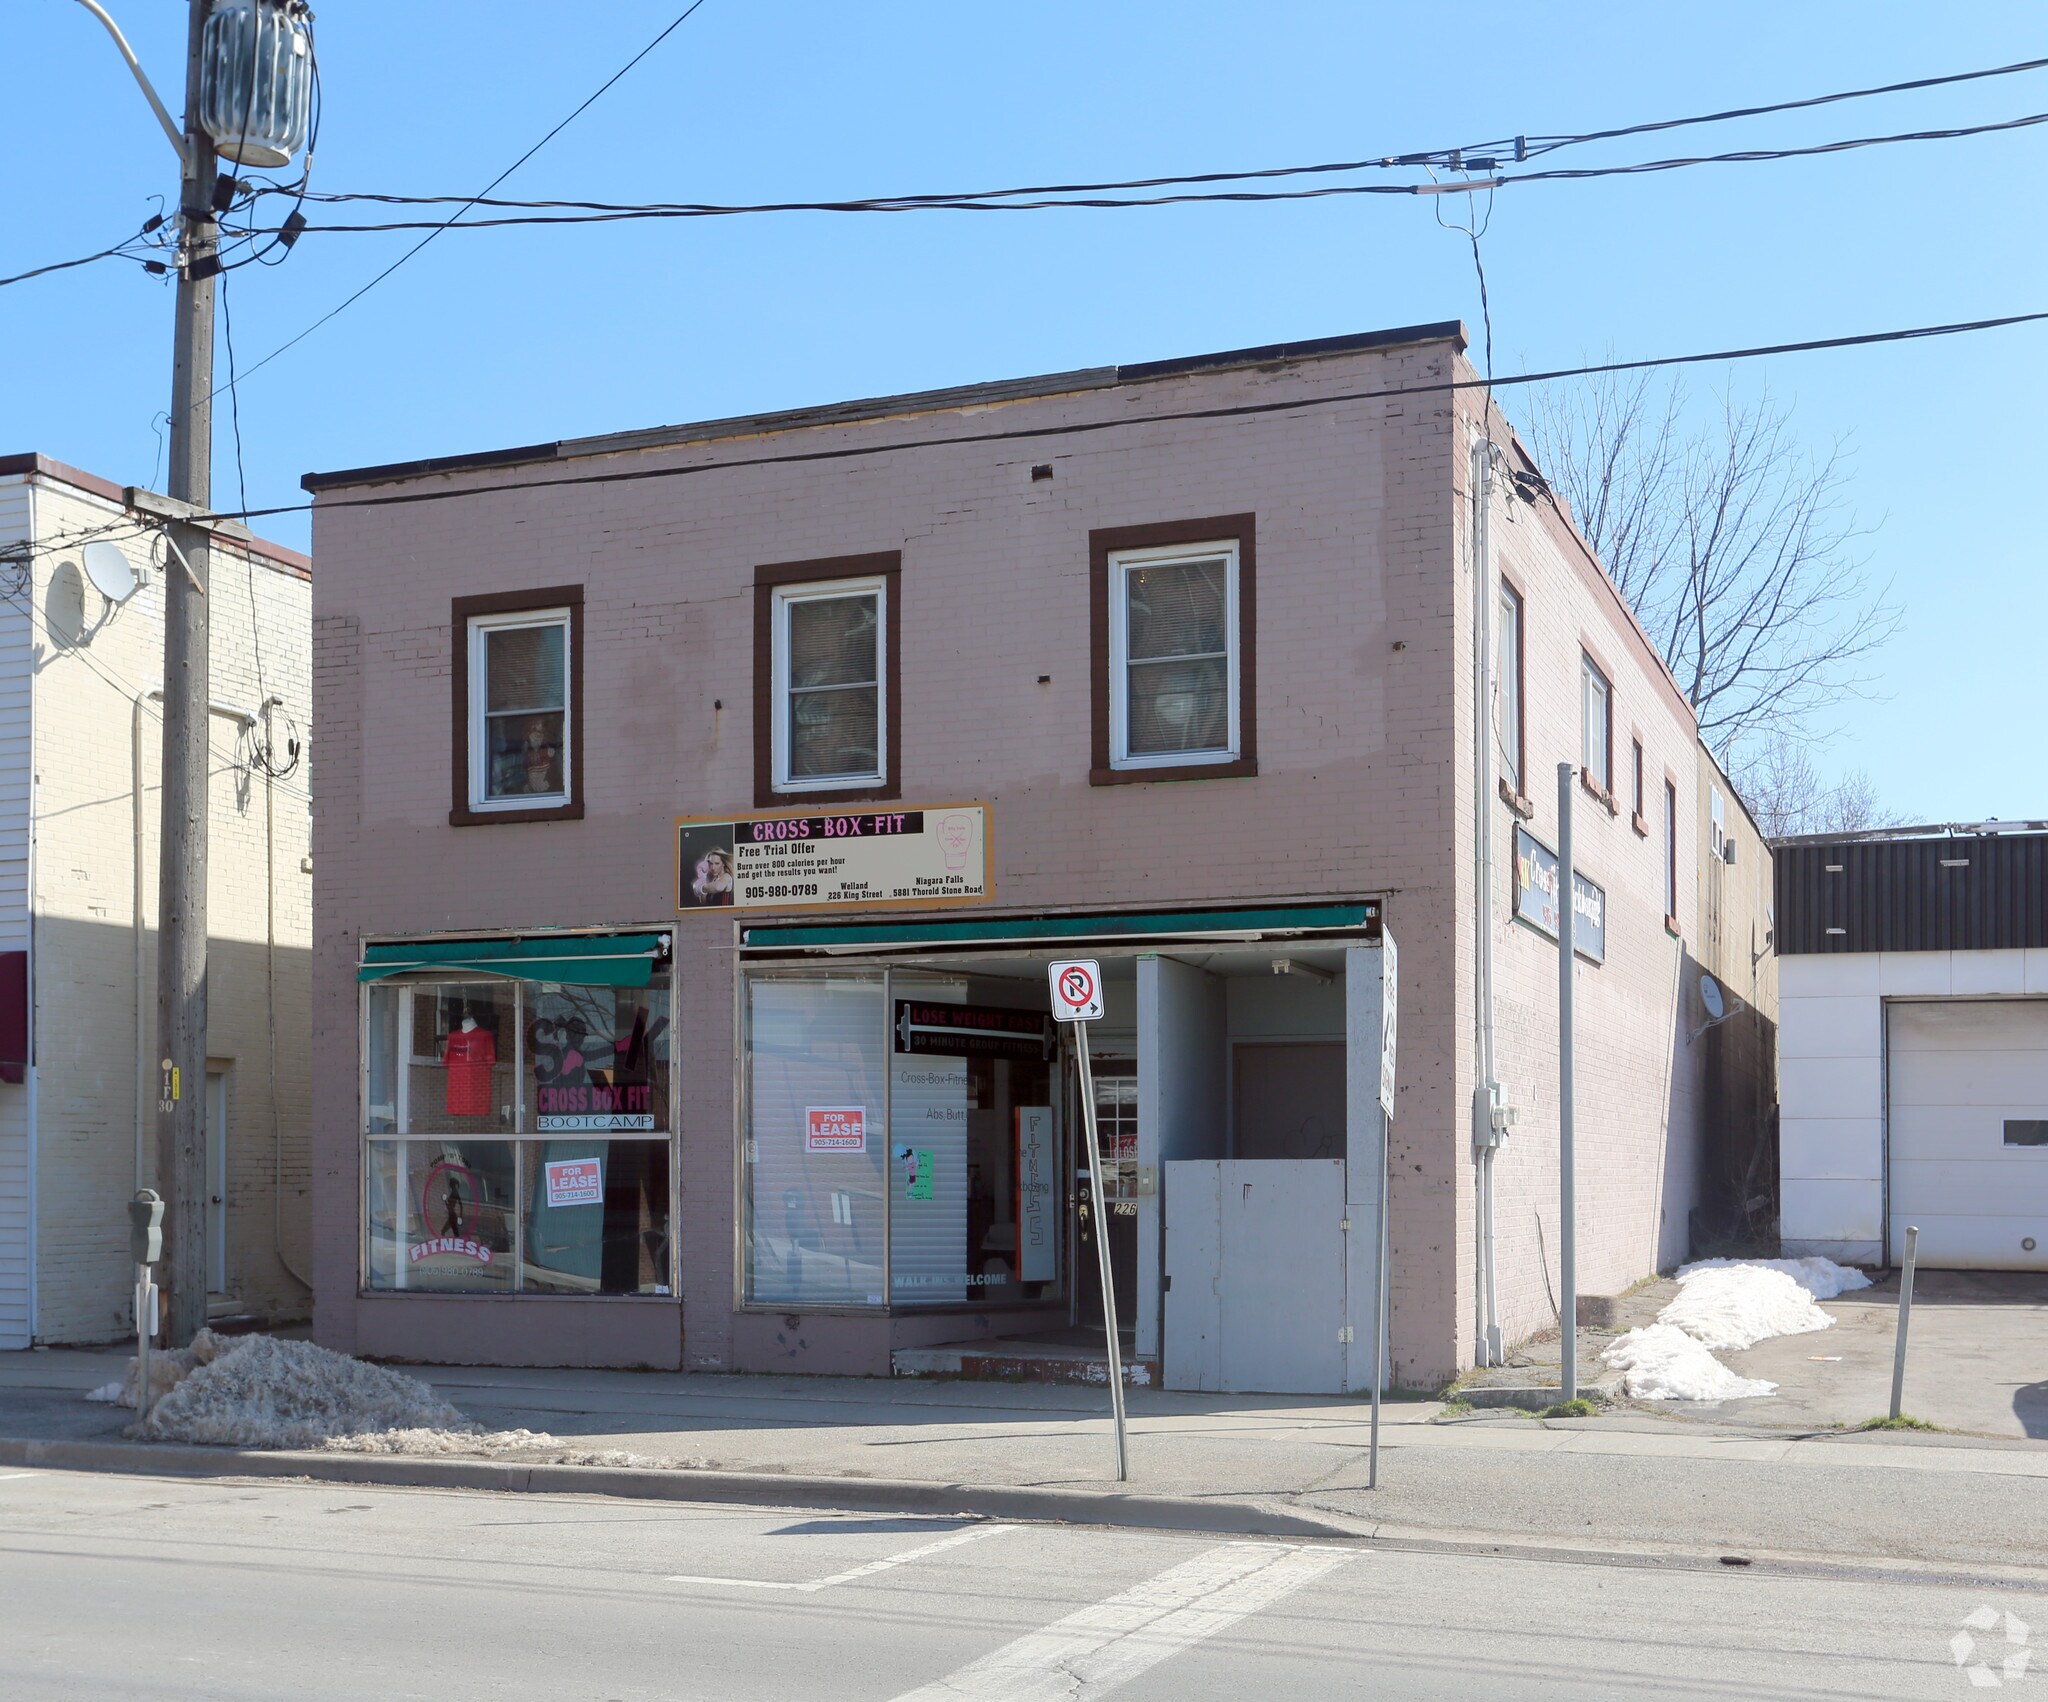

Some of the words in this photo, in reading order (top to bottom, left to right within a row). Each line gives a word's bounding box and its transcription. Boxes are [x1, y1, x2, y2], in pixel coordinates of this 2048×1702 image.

[753, 820, 810, 841] CROSS
[739, 846, 760, 857] Free
[764, 844, 787, 856] Trial
[791, 843, 815, 854] Offer
[737, 862, 753, 871] Burn
[755, 861, 770, 869] over
[772, 860, 785, 868] 800
[787, 858, 814, 868] calories
[817, 858, 829, 867] per
[830, 857, 845, 865] hour
[737, 870, 750, 879] and
[751, 870, 762, 880] get
[764, 869, 775, 877] the
[777, 868, 801, 877] results
[803, 867, 816, 877] you
[818, 866, 838, 874] want!
[841, 881, 869, 890] Welland
[916, 877, 943, 887] Niagara
[945, 875, 964, 884] Falls
[745, 883, 818, 898] 905-980-0789
[828, 891, 842, 900] 226
[843, 891, 860, 901] King
[861, 890, 883, 899] Street
[912, 887, 940, 896] Thorold
[941, 886, 962, 895] Stone
[964, 885, 983, 894] Road
[913, 1009, 946, 1024] LOSE
[952, 1011, 1004, 1028] WEIGHT
[929, 1036, 967, 1048] MINUTE
[537, 1087, 588, 1112] CROSS
[591, 1086, 623, 1111] BOX
[627, 1085, 650, 1110] FIT
[159, 1100, 174, 1112] 30
[538, 1115, 653, 1128] BOOTCAMP
[823, 1113, 845, 1122] FOR
[811, 1122, 862, 1136] LEASE
[813, 1138, 858, 1146] 905-714-1600
[562, 1167, 582, 1176] FOR
[551, 1174, 598, 1190] LEASE
[554, 1190, 595, 1200] 905-714-1600
[1115, 1202, 1137, 1215] 226
[410, 1238, 491, 1262] FITNESS
[894, 1275, 928, 1288] WALK
